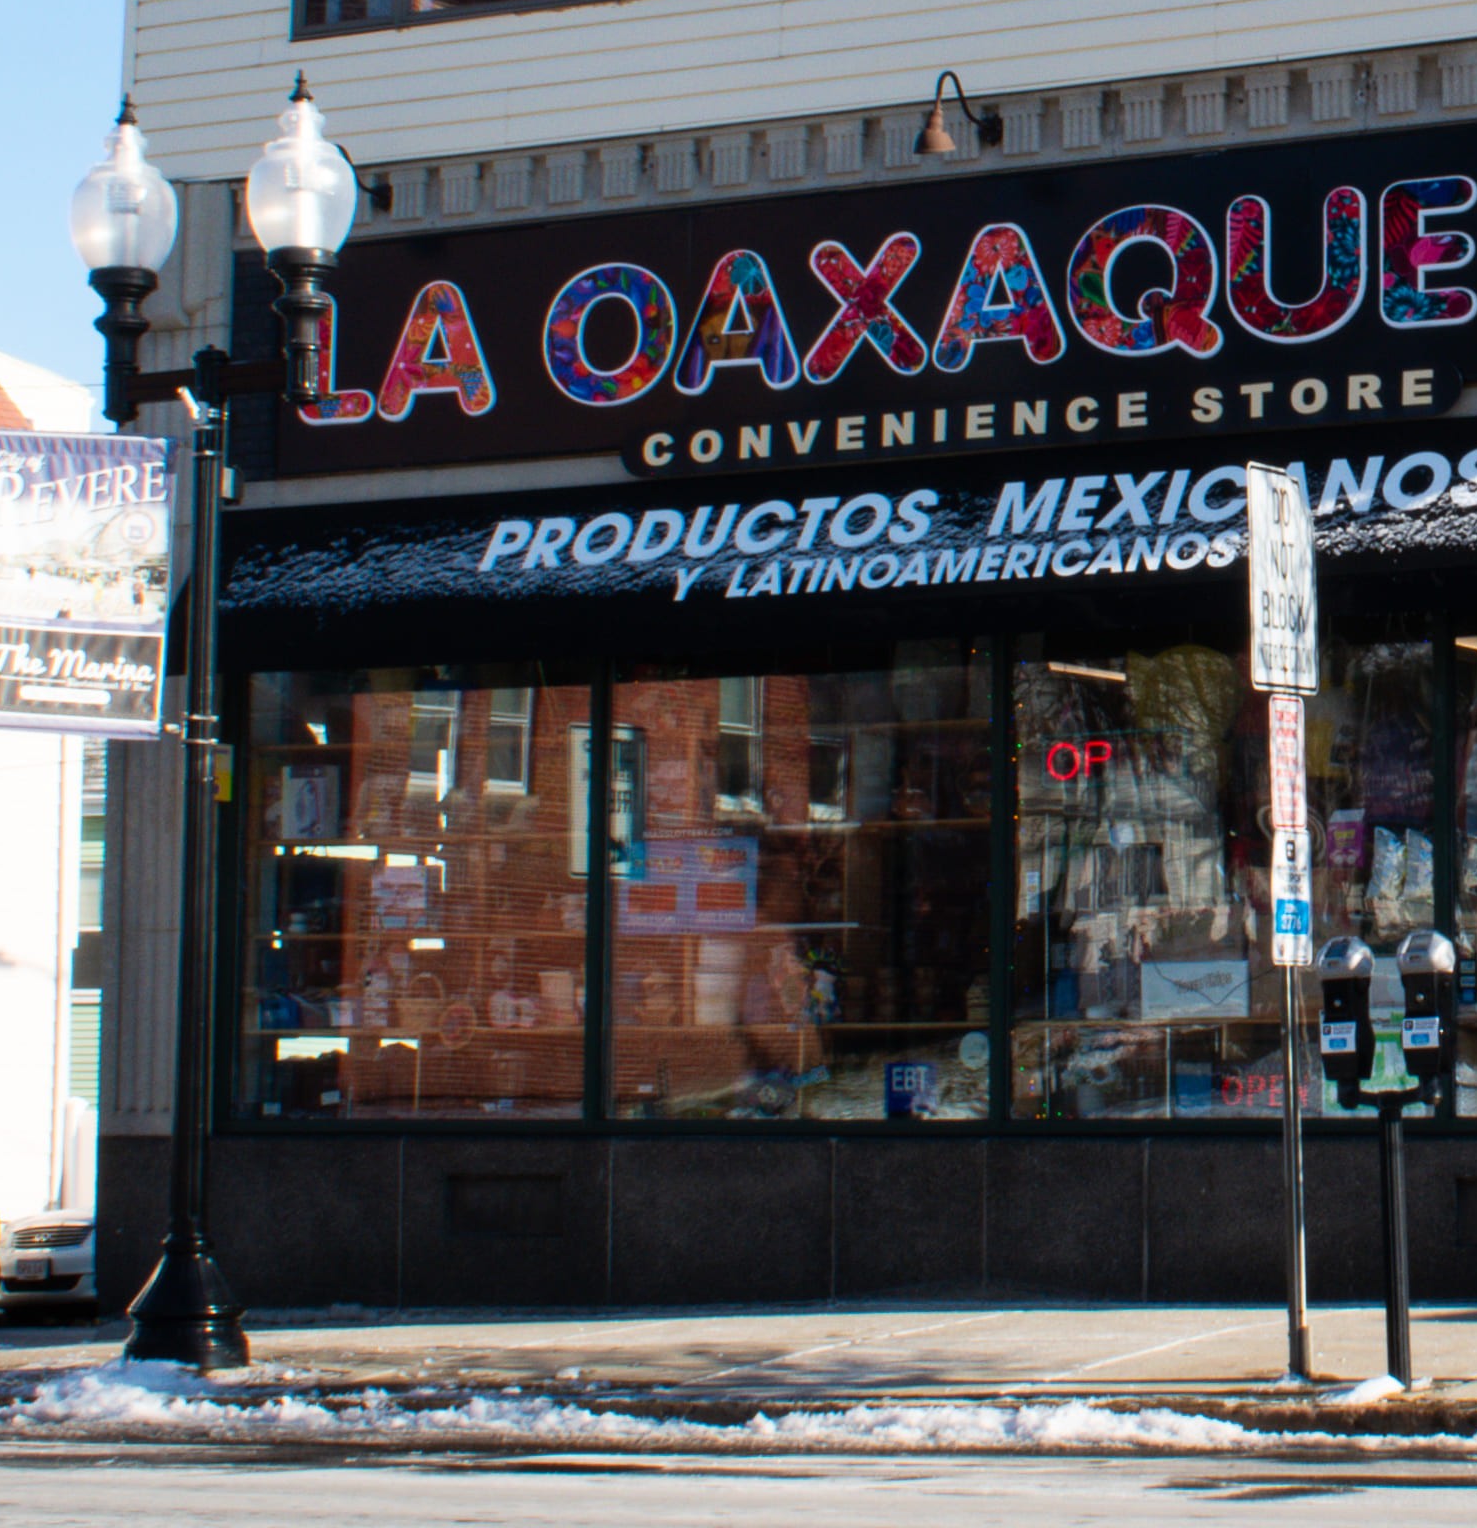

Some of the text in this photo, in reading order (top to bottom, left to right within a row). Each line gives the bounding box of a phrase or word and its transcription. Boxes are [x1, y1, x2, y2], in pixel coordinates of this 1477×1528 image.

[297, 280, 497, 426] LA
[642, 368, 1435, 467] CONVENIENCE STORE
[1271, 487, 1291, 527] DO
[478, 488, 939, 572] PRODUCTOS
[673, 530, 1238, 601] Y LATINOAMERICANOS
[1270, 542, 1295, 579] NOT
[1262, 591, 1305, 633] BLOCK
[49, 649, 155, 682] Marina
[892, 1066, 928, 1091] EBT
